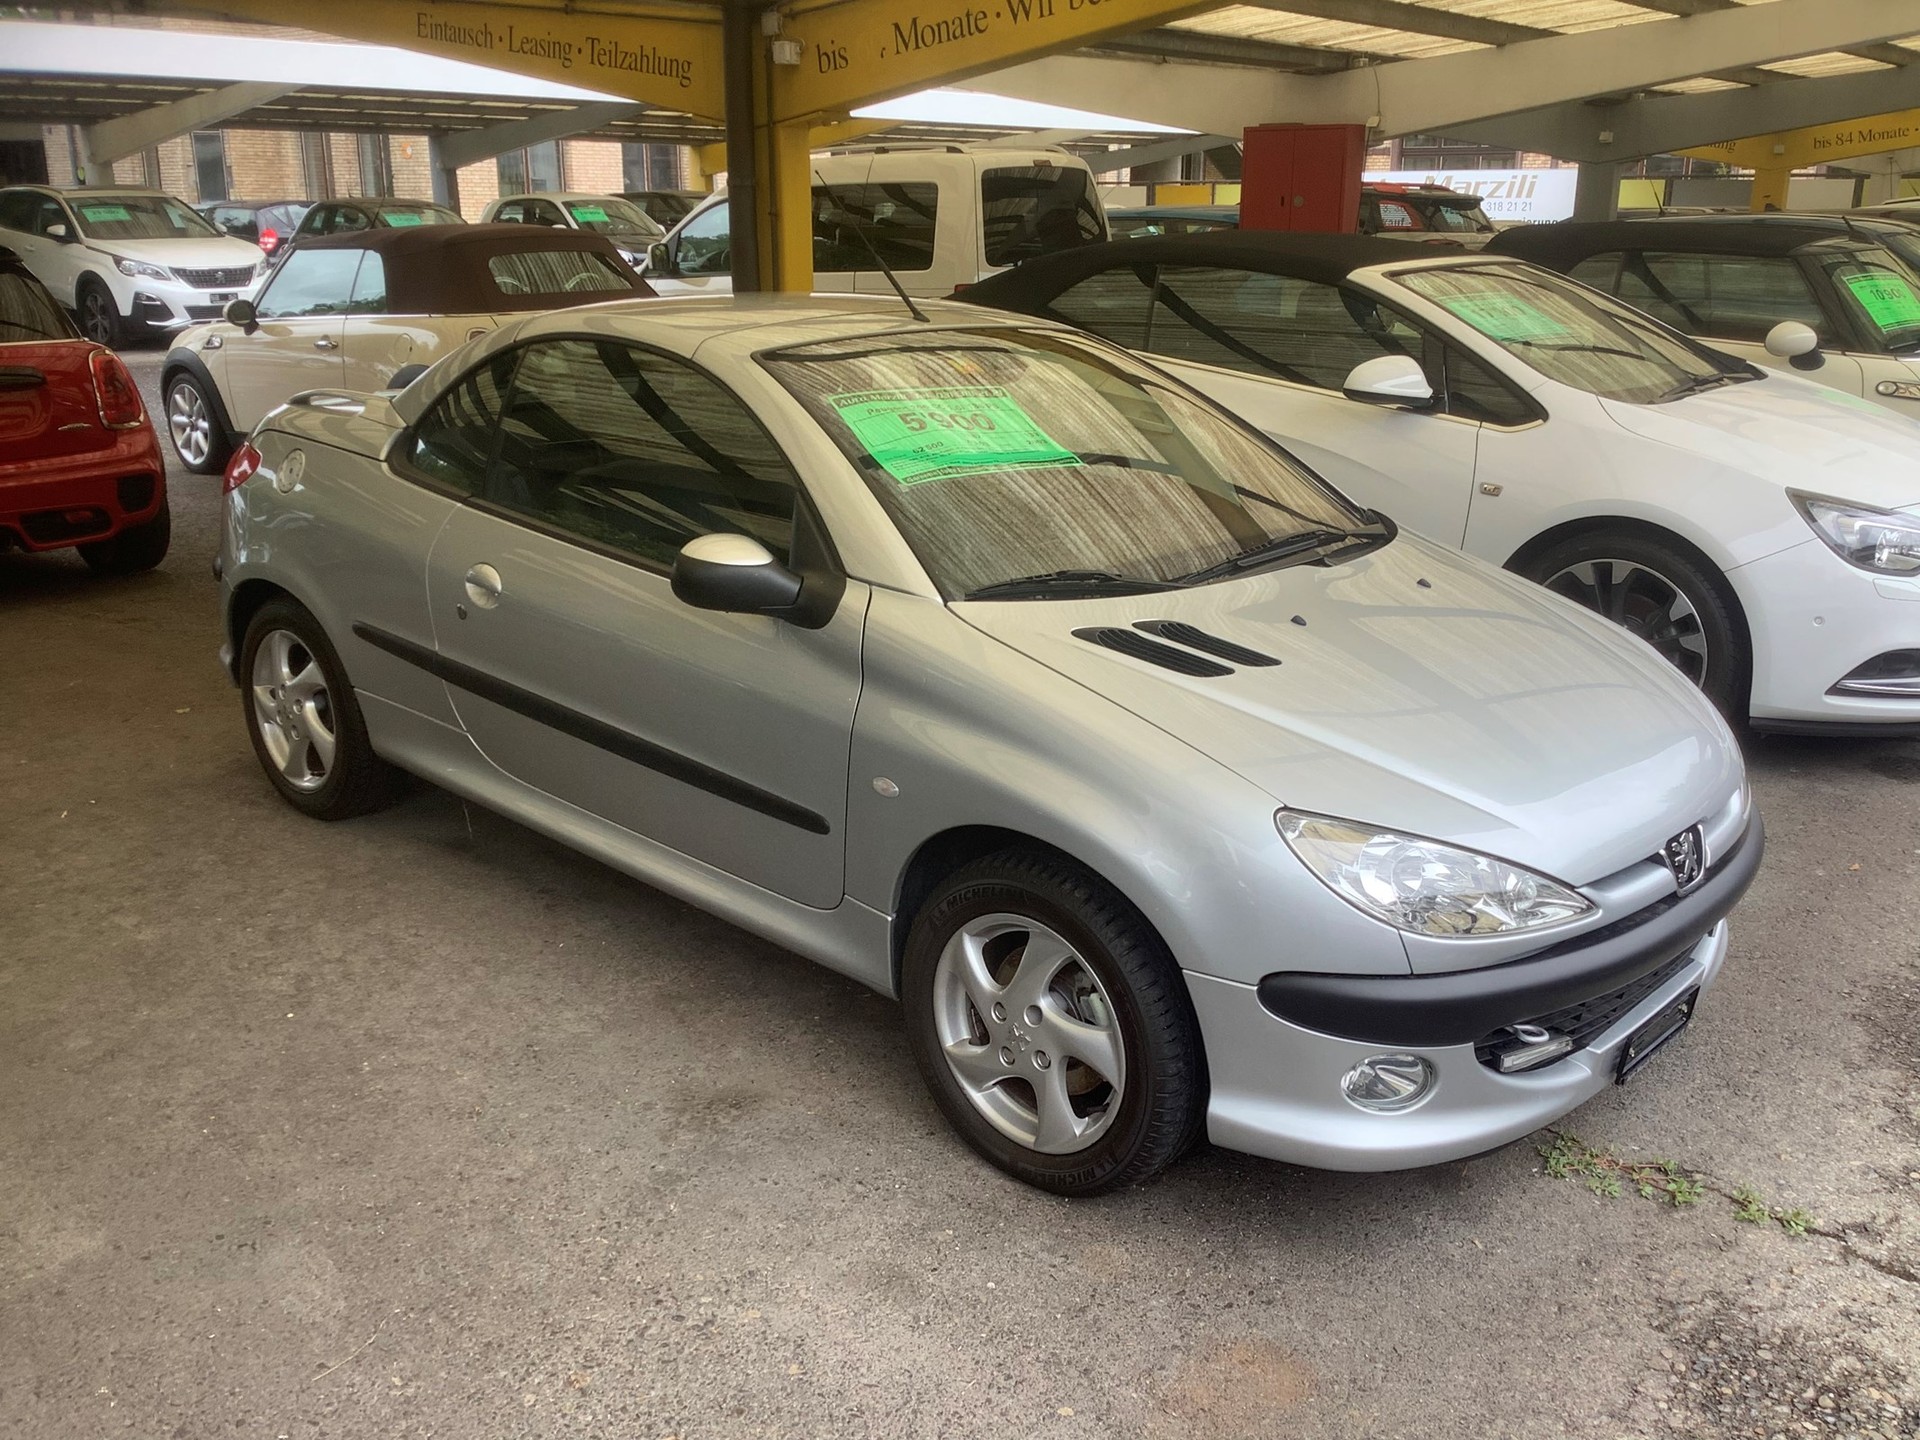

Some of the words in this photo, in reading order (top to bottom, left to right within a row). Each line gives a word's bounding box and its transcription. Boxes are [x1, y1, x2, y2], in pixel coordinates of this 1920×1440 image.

[417, 13, 493, 49] Eintausch
[508, 25, 572, 68] Leasing
[586, 36, 693, 87] Teilzahlung
[815, 41, 849, 74] bis
[892, 8, 988, 55] Monate
[1813, 135, 1832, 150] bis
[1836, 132, 1854, 147] 84
[1858, 126, 1910, 144] Monate
[1486, 201, 1504, 212] 318
[1507, 201, 1518, 212] 21
[1521, 201, 1533, 212] 21
[899, 412, 996, 432] 5'900
